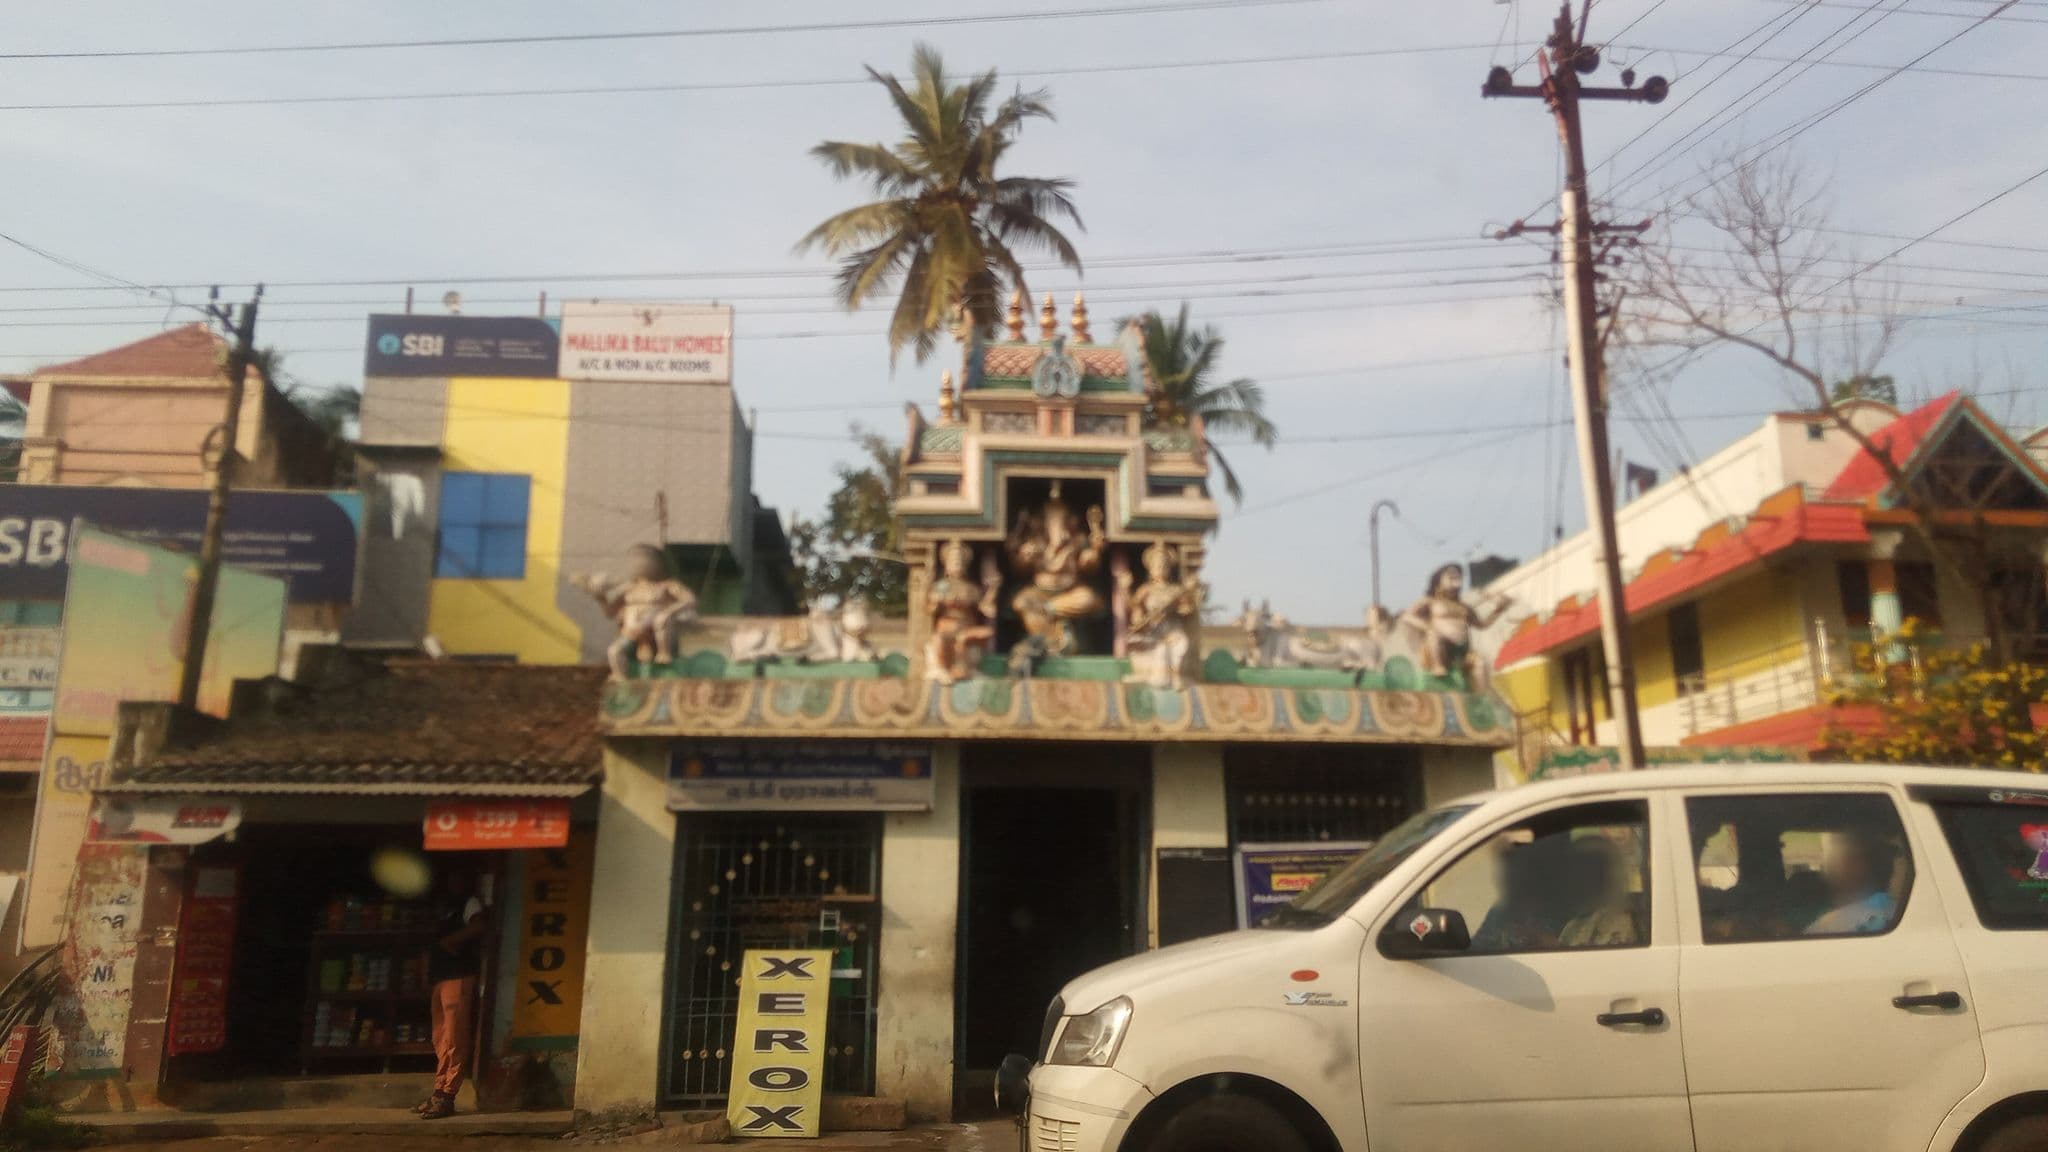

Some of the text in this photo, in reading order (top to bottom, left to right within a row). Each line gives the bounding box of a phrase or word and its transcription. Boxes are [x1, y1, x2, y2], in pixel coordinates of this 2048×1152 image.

[402, 333, 445, 357] SBI
[674, 335, 724, 354] HOMES
[579, 358, 600, 370] A/C
[615, 359, 641, 371] NON
[645, 360, 666, 372] A/C
[669, 360, 712, 373] ROOMS
[0, 518, 71, 564] SB
[742, 957, 816, 1132] XEROX
